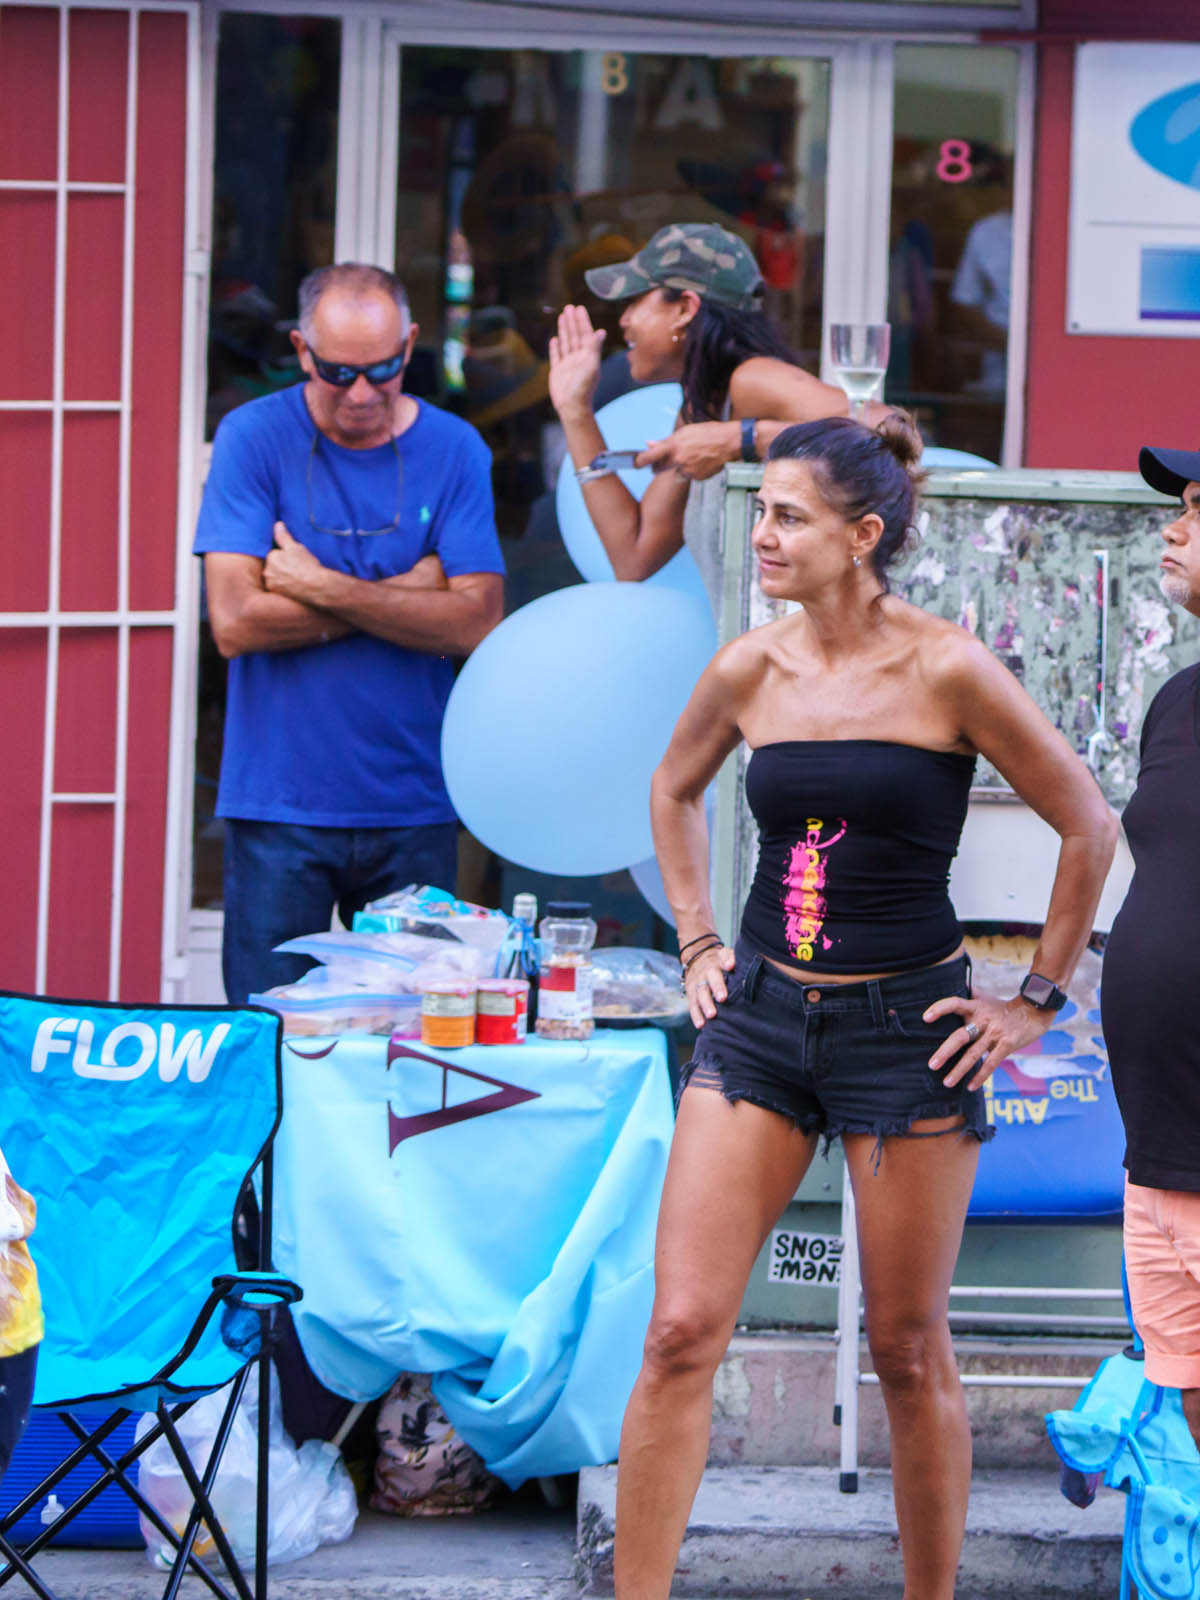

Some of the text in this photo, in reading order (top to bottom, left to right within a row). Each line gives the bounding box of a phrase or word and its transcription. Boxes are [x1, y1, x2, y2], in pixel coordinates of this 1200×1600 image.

[603, 52, 628, 95] 8
[937, 139, 972, 182] 8
[31, 1018, 230, 1084] FLOW
[986, 1078, 1099, 1125] The Athl
